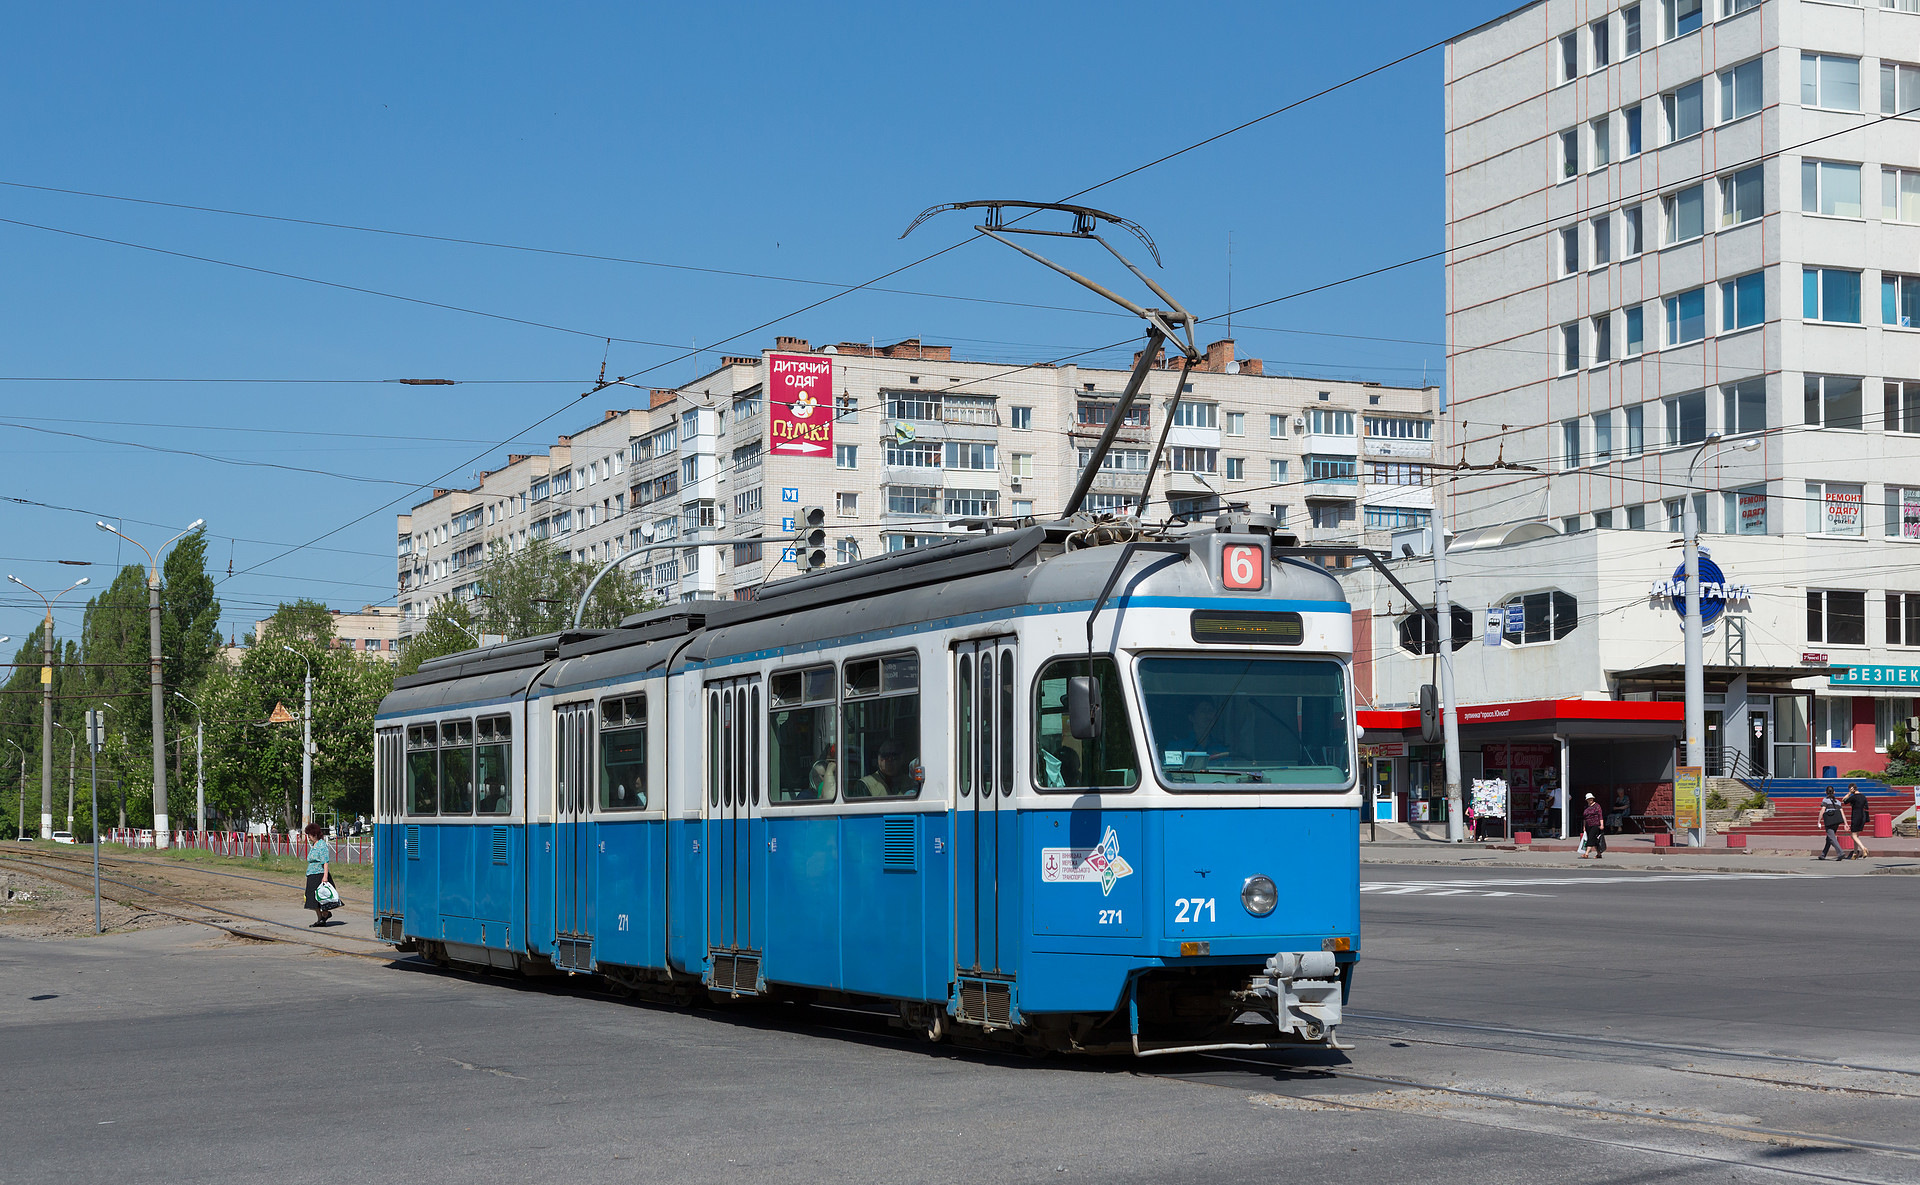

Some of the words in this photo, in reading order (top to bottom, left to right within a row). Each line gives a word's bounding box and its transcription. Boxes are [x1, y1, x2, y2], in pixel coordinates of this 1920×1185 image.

[773, 360, 830, 374] ДИТЯЧИЙ
[785, 375, 818, 388] ОДЯГ
[1825, 493, 1862, 502] РЕМОНТ
[1742, 507, 1766, 519] ОДЯГУ
[1829, 506, 1859, 515] ОДЯГУ
[1230, 546, 1253, 584] 6
[1650, 580, 1753, 599] АМГАМА
[1849, 668, 1919, 682] БЕЗПЕК
[1098, 909, 1122, 924] 271
[1174, 898, 1216, 923] 271
[617, 914, 629, 931] 271
